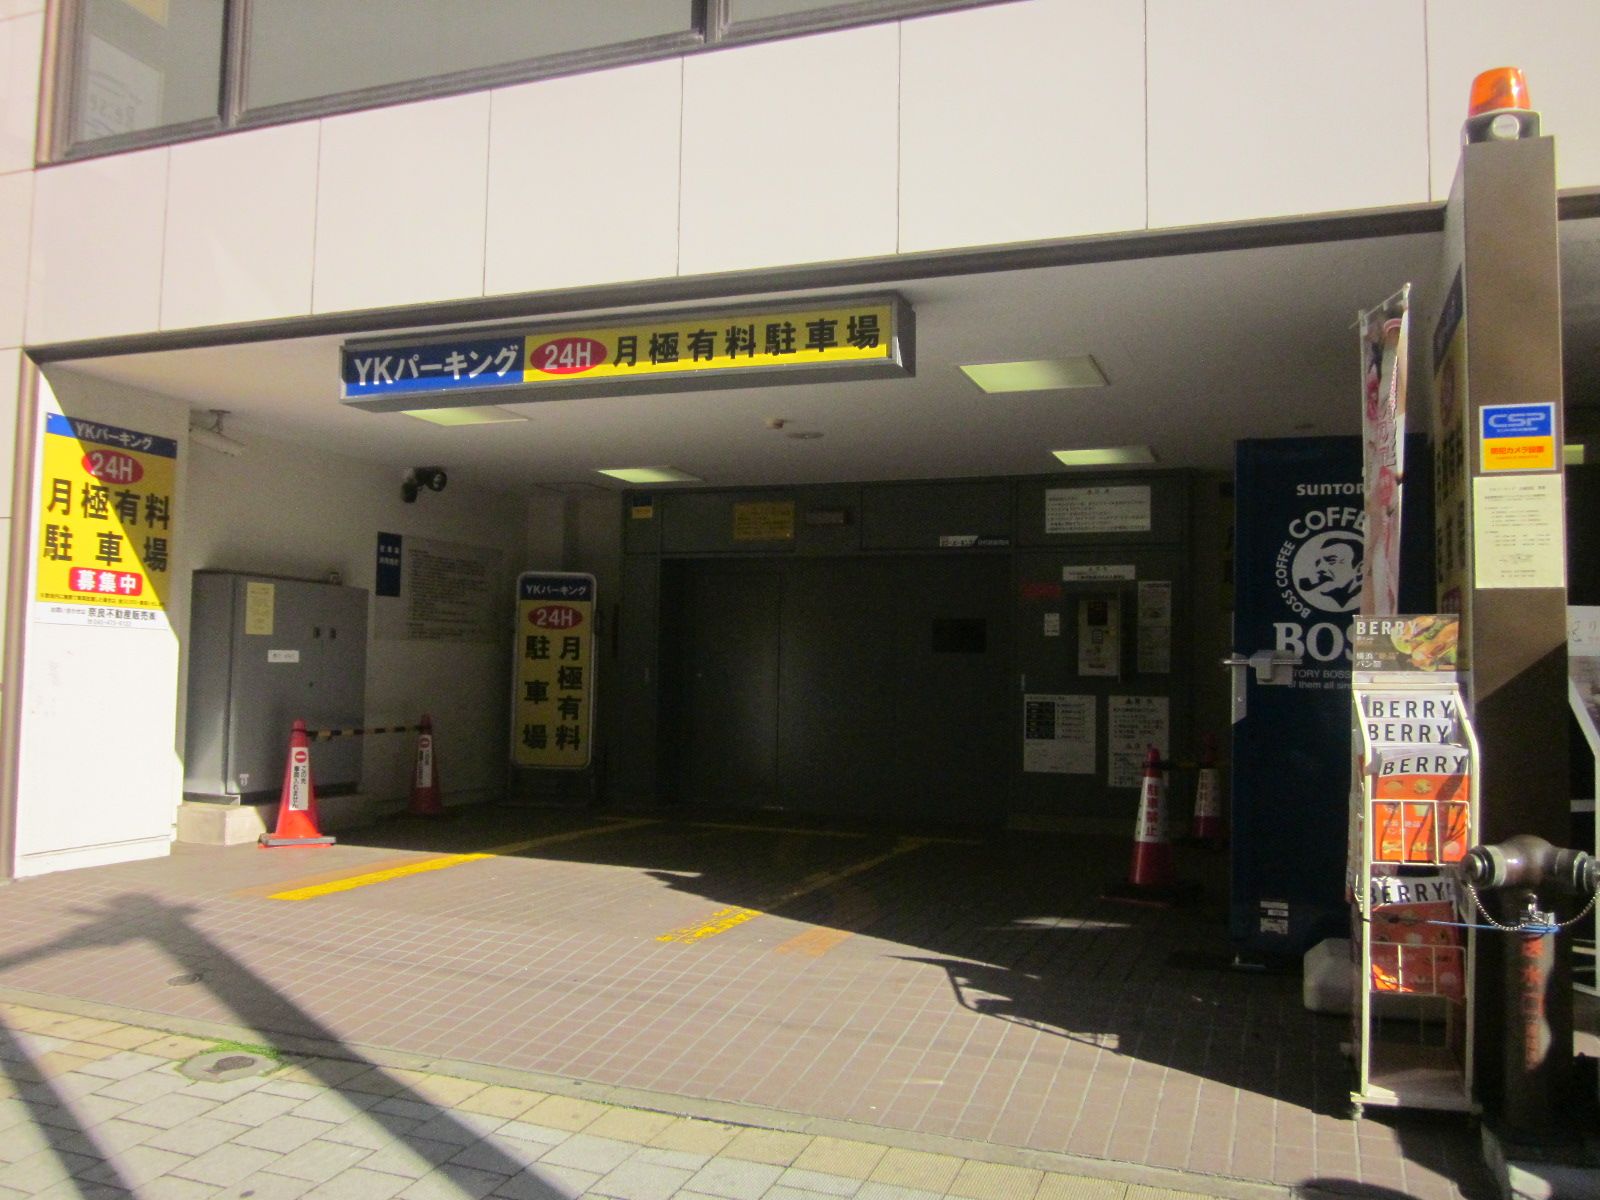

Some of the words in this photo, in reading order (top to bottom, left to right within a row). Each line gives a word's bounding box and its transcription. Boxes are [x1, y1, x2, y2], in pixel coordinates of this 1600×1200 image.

[353, 343, 519, 387] YKパーキング
[543, 341, 592, 370] 24H
[612, 315, 881, 369] 月極有料駐車場
[1488, 412, 1546, 428] CSP
[73, 420, 154, 452] YKパーキング
[89, 451, 135, 482] 24H
[47, 477, 170, 531] 月極有料
[1297, 482, 1364, 496] SUNTOR
[1288, 506, 1365, 539] COFFE
[43, 523, 169, 574] 駐車場
[1275, 540, 1297, 588] COFFEE
[76, 568, 137, 595] 募集中
[525, 584, 587, 596] YKパーキング
[536, 608, 573, 627] 24H
[1281, 590, 1312, 619] BOSS
[1273, 622, 1354, 662] BO
[1356, 621, 1417, 635] BERRY
[523, 635, 550, 750] 駐車場
[555, 636, 583, 751] 月極有料
[1372, 700, 1452, 719] BERRY
[1368, 723, 1449, 744] BERRY
[1382, 755, 1466, 776] BERRY
